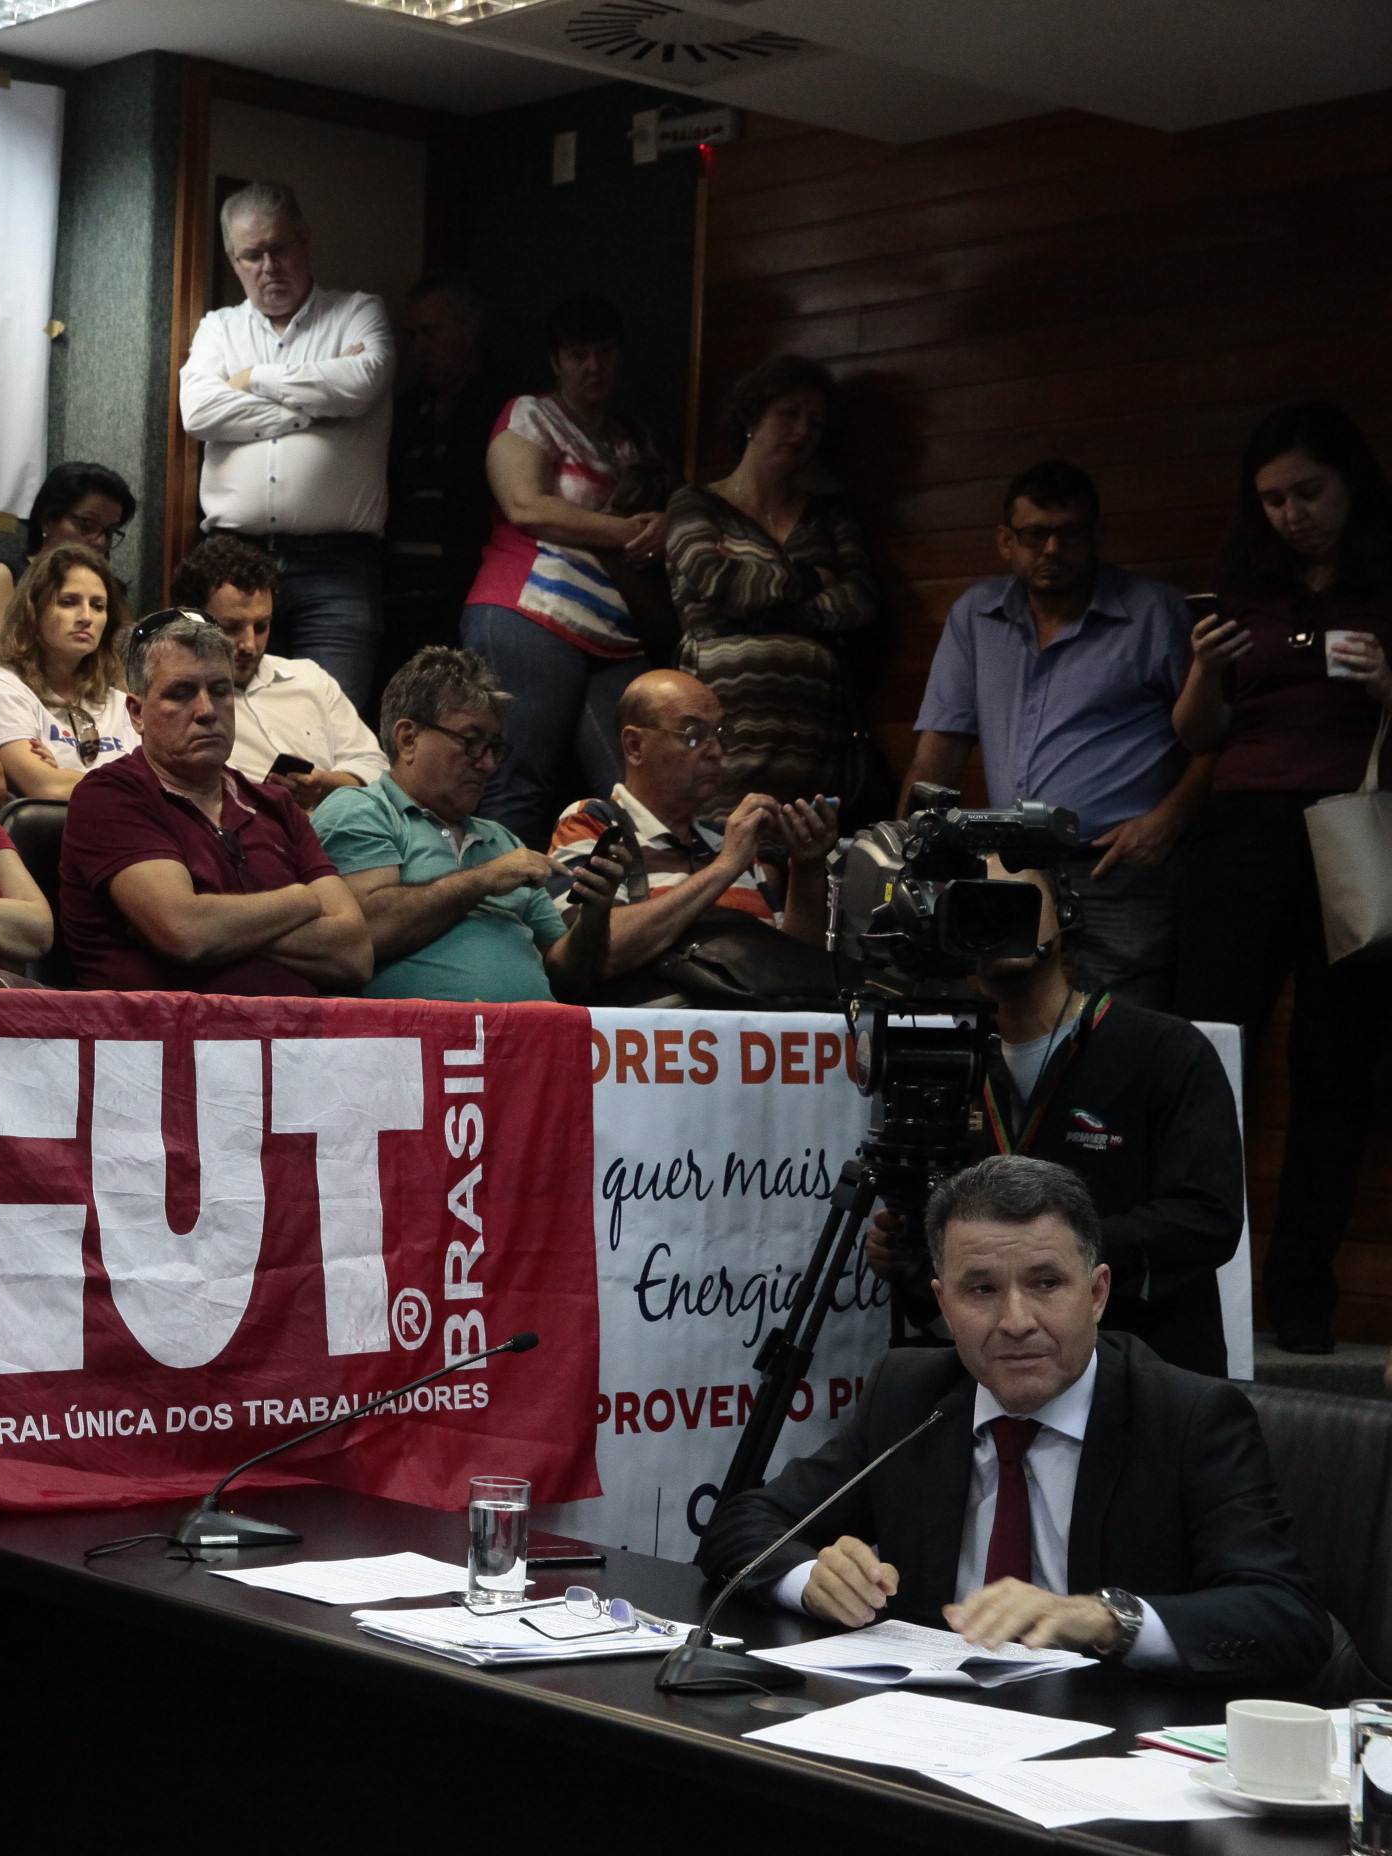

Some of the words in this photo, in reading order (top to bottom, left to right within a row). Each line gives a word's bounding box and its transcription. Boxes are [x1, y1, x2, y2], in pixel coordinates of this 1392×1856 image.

[1066, 1131, 1109, 1145] PRIMER
[442, 1014, 488, 1372] BRASIL
[601, 1149, 715, 1251] quer
[722, 1147, 833, 1200] mais
[64, 1404, 158, 1440] ÚNICA
[165, 1404, 234, 1434] DOS
[242, 1382, 490, 1427] TRABALHADORES
